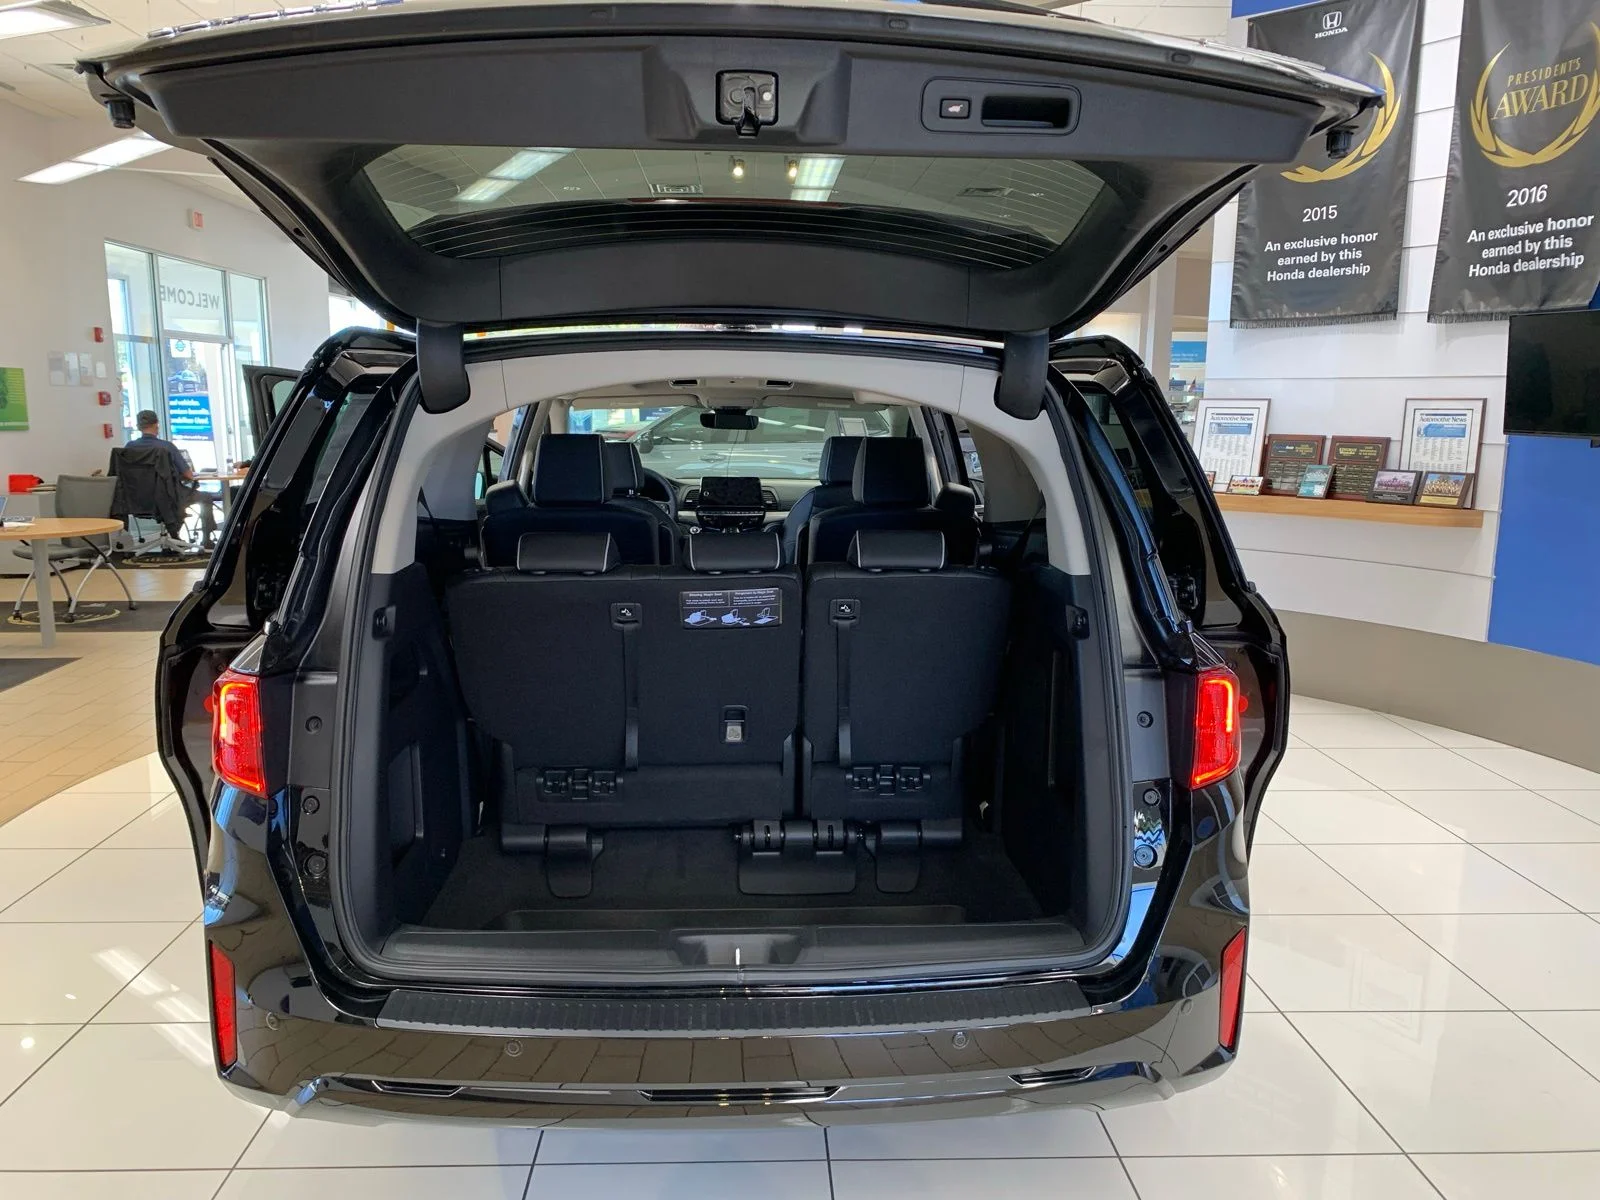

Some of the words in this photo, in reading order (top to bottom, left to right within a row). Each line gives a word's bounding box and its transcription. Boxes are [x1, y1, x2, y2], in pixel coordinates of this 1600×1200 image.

[1315, 27, 1348, 39] HONDA
[1507, 57, 1581, 87] PRESIDENT'S
[1491, 73, 1589, 120] AWARD
[1506, 184, 1548, 208] 2016
[1302, 205, 1338, 222] 2015
[1467, 229, 1485, 243] An
[1488, 221, 1544, 240] exclusive
[1547, 215, 1595, 231] honor
[1264, 241, 1281, 252] An
[1284, 235, 1338, 250] exclusive
[1341, 232, 1379, 244] honor
[1482, 240, 1522, 259] earned
[1525, 239, 1542, 255] by
[1543, 234, 1573, 251] this
[1277, 252, 1318, 266] earned
[1320, 250, 1336, 263] by
[1339, 248, 1363, 260] this
[1468, 261, 1511, 277] Honda
[1513, 252, 1585, 273] dealership
[1267, 269, 1305, 282] Honda
[1307, 263, 1371, 278] dealership
